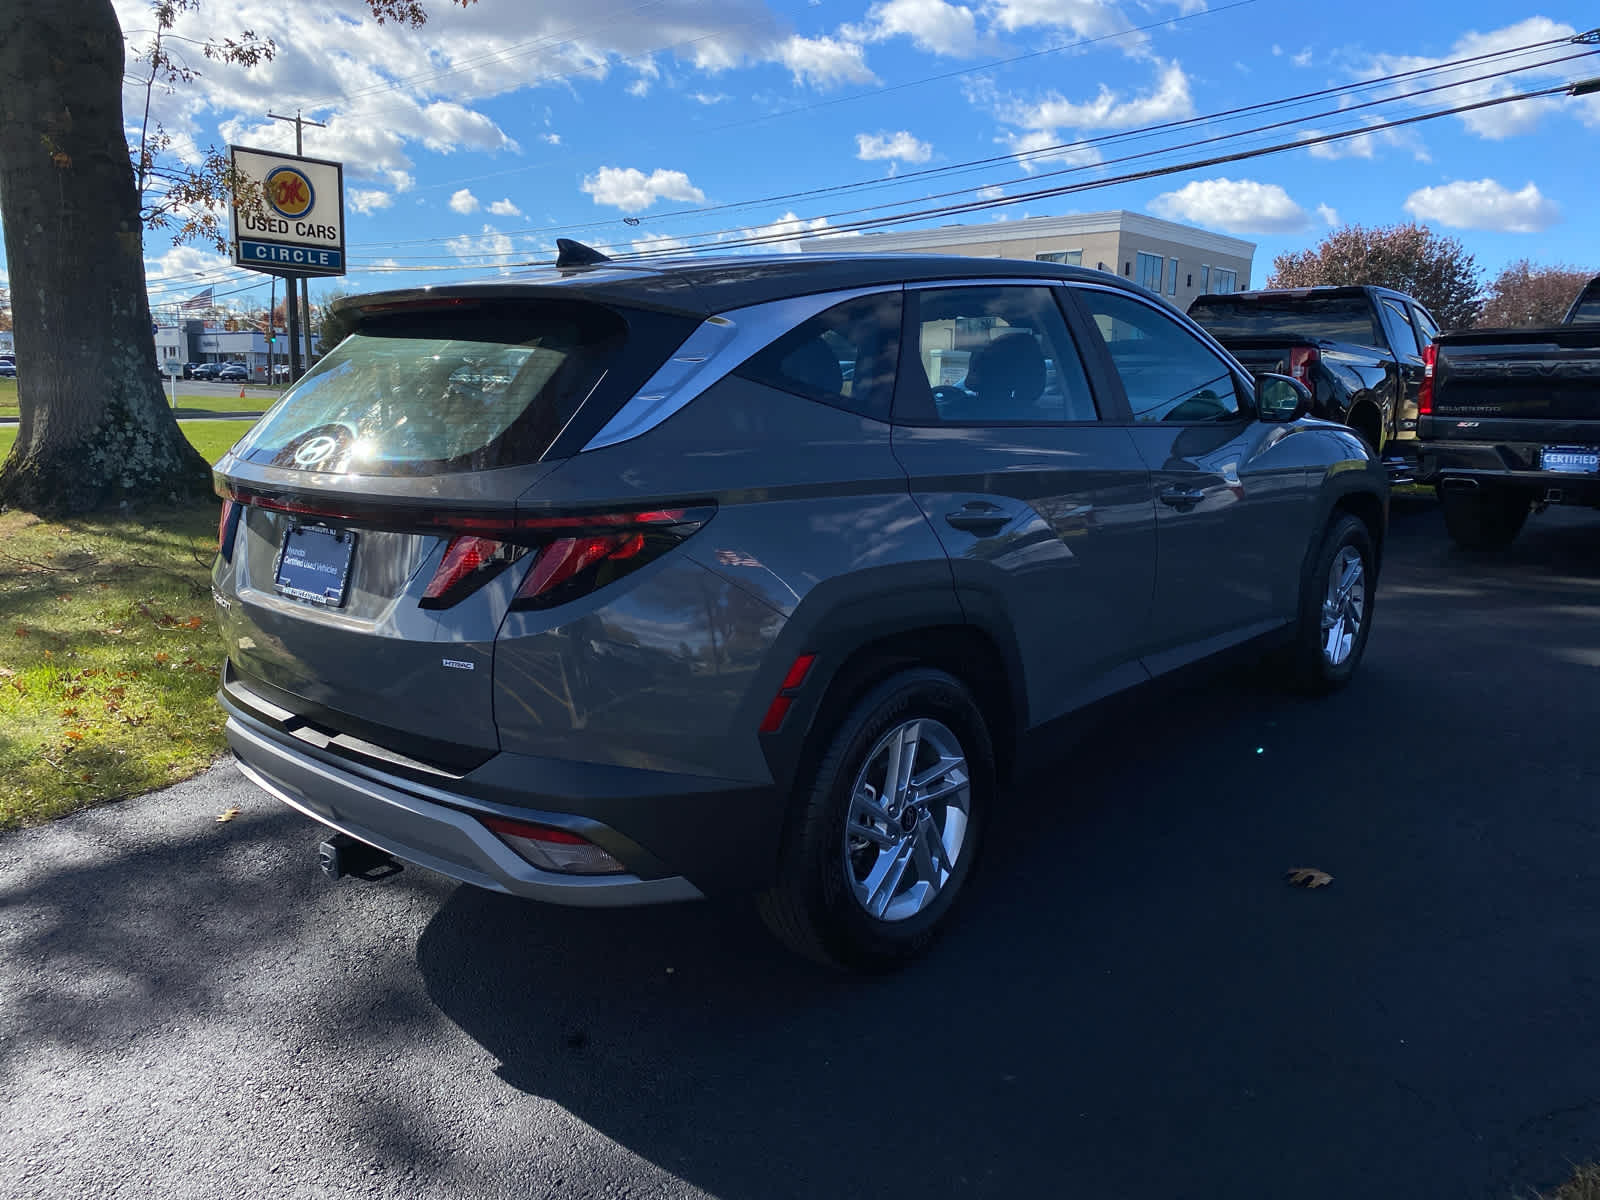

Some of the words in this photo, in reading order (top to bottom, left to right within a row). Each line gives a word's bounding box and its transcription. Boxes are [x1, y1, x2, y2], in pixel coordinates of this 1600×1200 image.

[277, 178, 306, 205] OK
[246, 216, 289, 234] USED
[295, 222, 337, 240] CARS
[256, 246, 329, 265] CIRCLE
[1544, 454, 1598, 464] CERTIFIED
[283, 555, 304, 568] Certified
[443, 660, 473, 669] HTRAC
